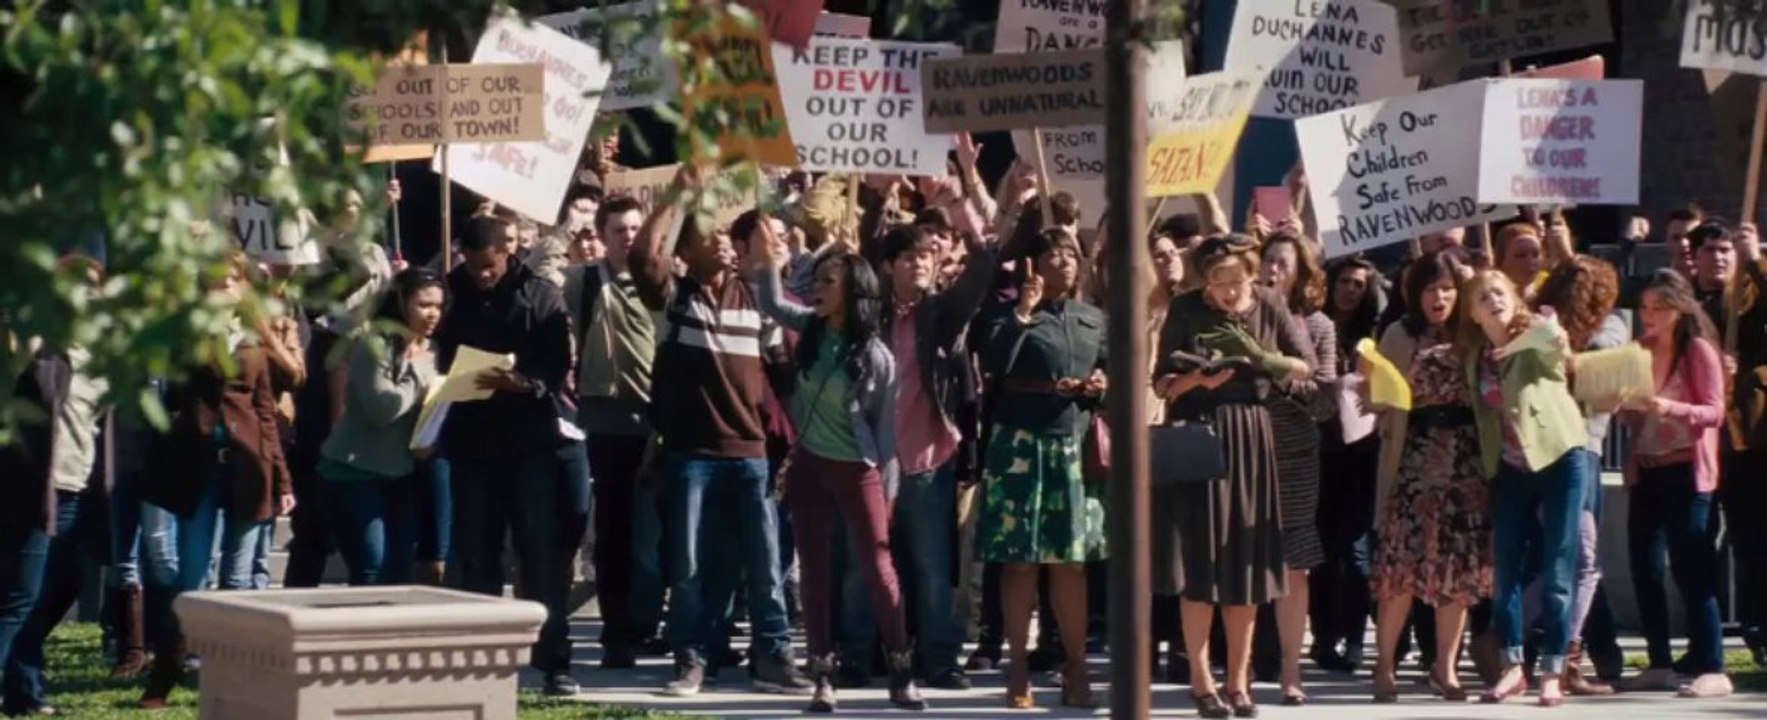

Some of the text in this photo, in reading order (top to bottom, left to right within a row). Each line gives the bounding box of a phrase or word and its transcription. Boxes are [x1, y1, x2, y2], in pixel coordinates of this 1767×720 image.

[1059, 17, 1081, 29] are
[1295, 0, 1359, 24] LENA
[1252, 16, 1386, 55] DUCHANNES
[792, 45, 868, 66] KEEP
[1300, 49, 1351, 72] WILL
[396, 76, 521, 95] OUT OF OUR
[813, 69, 911, 94] DEVIL
[932, 62, 1094, 90] RAVENWOODS
[1313, 72, 1359, 97] OUR
[450, 100, 480, 117] AND
[489, 97, 523, 115] OUT
[805, 96, 914, 119] OUT OF
[979, 90, 1105, 116] UNNATURAL
[1580, 87, 1598, 106] A
[400, 123, 443, 140] OUR
[453, 117, 519, 139] TOWN!
[827, 122, 887, 143] OUR
[1044, 131, 1097, 148] FROM
[1341, 111, 1438, 147] Keep Our
[1519, 115, 1597, 141] DANGER
[796, 145, 918, 169] SCHOOL!
[1347, 144, 1429, 179] Children
[1523, 147, 1588, 169] TO OUR
[1356, 182, 1401, 210] Safe
